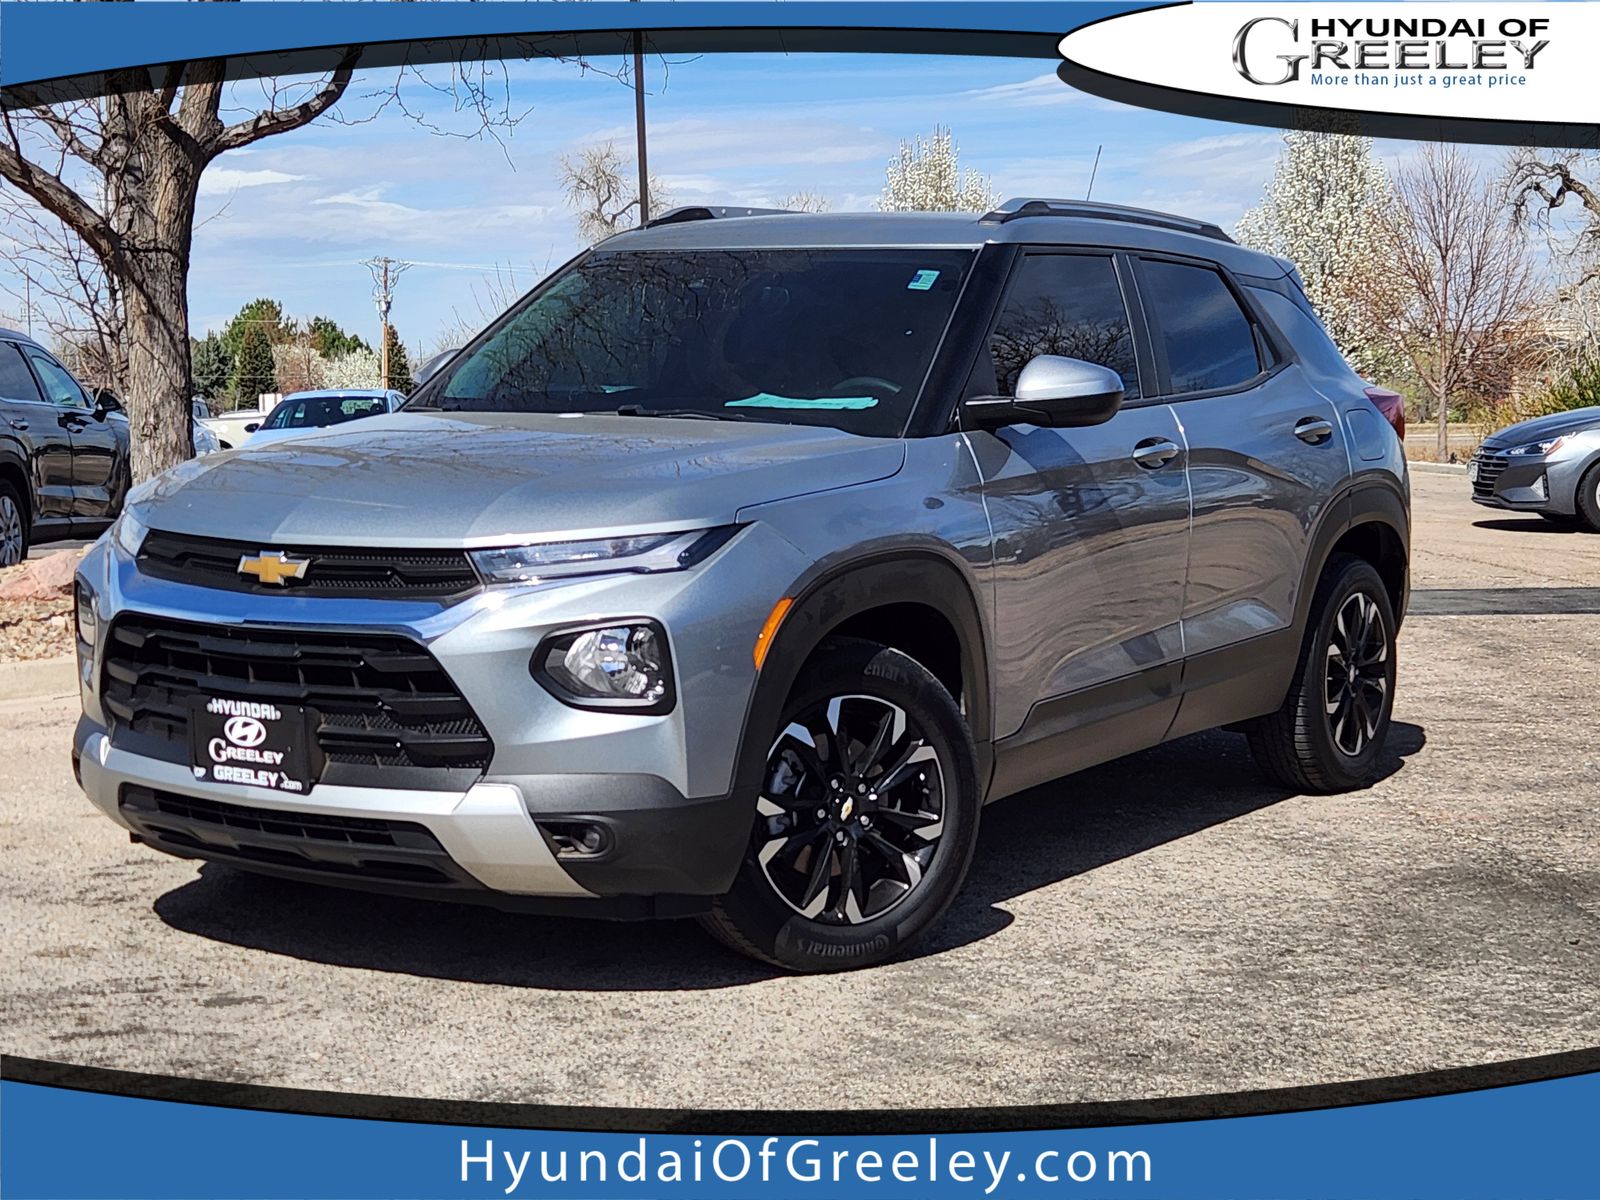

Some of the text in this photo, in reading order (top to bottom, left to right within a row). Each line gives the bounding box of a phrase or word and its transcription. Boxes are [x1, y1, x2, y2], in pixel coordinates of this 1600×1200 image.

[211, 698, 276, 720] HYUNDAI
[208, 737, 284, 765] GREELEY
[213, 764, 278, 787] GREELEY
[806, 933, 890, 958] Continental
